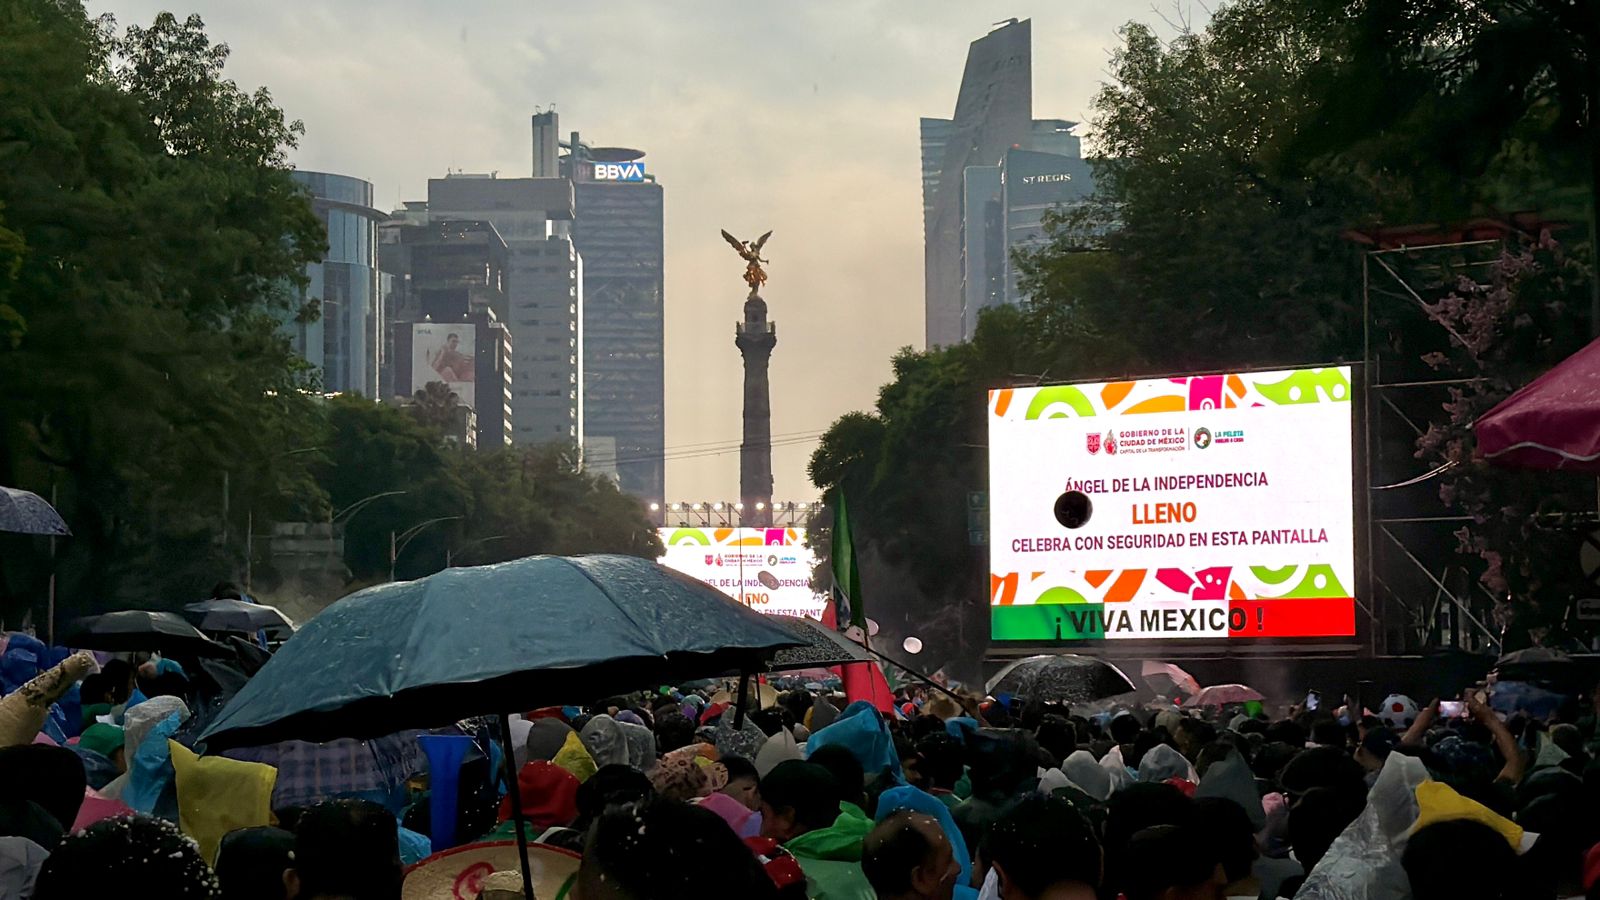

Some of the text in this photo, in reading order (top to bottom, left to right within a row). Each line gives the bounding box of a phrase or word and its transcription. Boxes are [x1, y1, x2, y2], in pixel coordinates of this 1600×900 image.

[595, 164, 642, 179] BBVA
[1037, 173, 1071, 183] REGIS
[1120, 430, 1159, 438] GOBIERNO
[1158, 437, 1185, 445] MÉXICO
[1065, 472, 1269, 493] ÁNGEL DE LA INDEPENDENCIA
[1132, 502, 1197, 524] LLENO
[1012, 528, 1329, 552] CELEBRA CON SEGURIDAD EN ESTA PANTALLA
[720, 579, 730, 587] DE
[732, 579, 742, 587] LA
